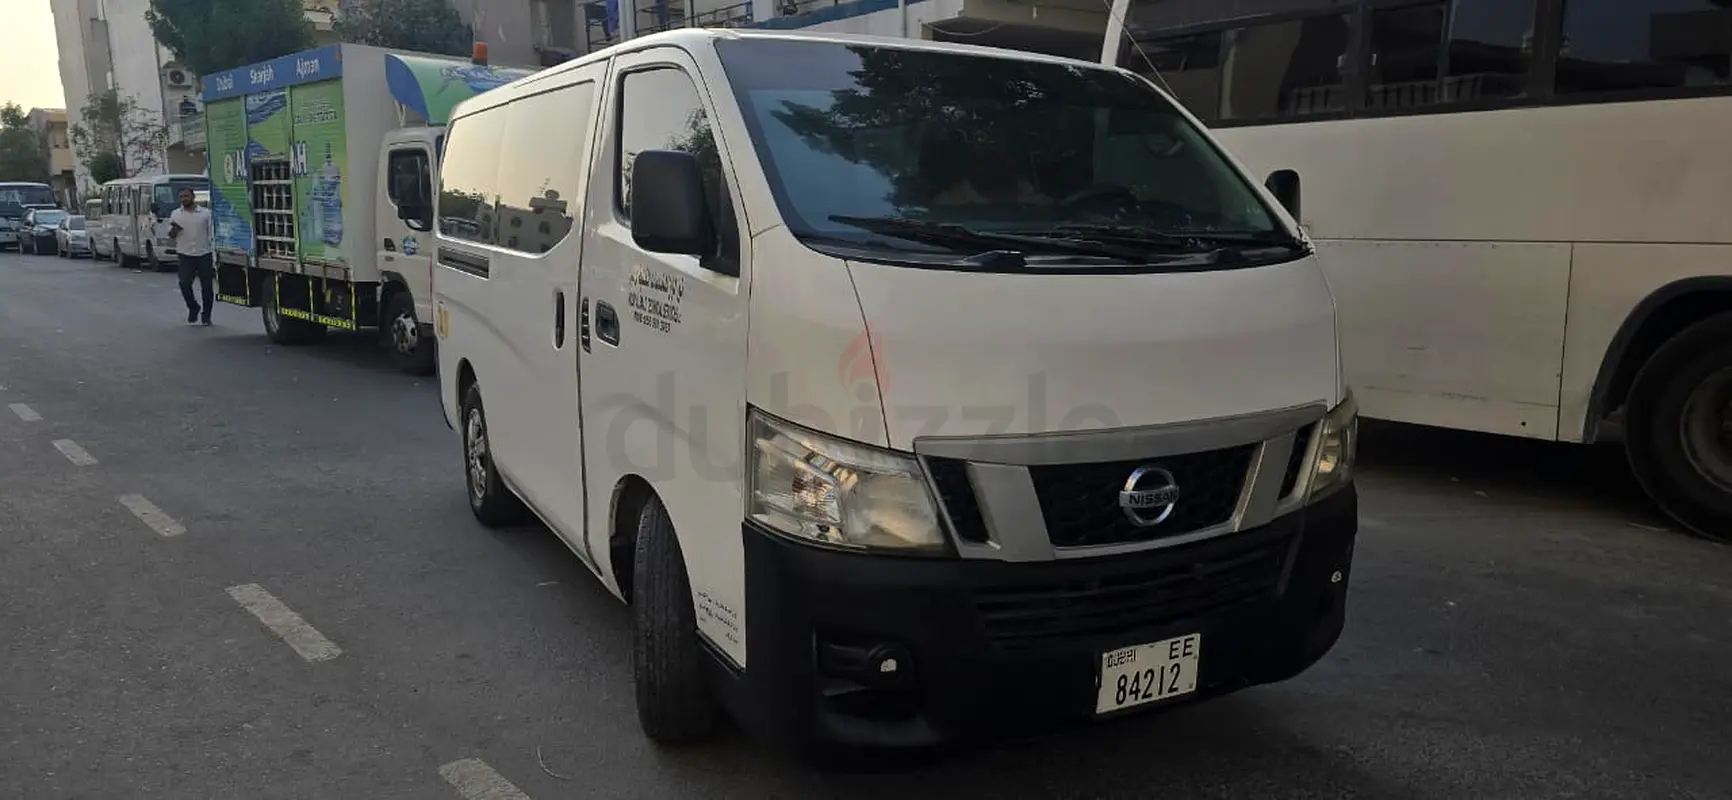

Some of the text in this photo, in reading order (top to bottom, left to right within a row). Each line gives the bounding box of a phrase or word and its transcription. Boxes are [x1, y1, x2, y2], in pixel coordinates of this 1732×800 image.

[216, 74, 233, 91] Dubai
[295, 58, 320, 80] Ajman
[1129, 488, 1175, 506] NISSAN
[1168, 637, 1195, 660] EE
[1116, 663, 1180, 705] 84212
